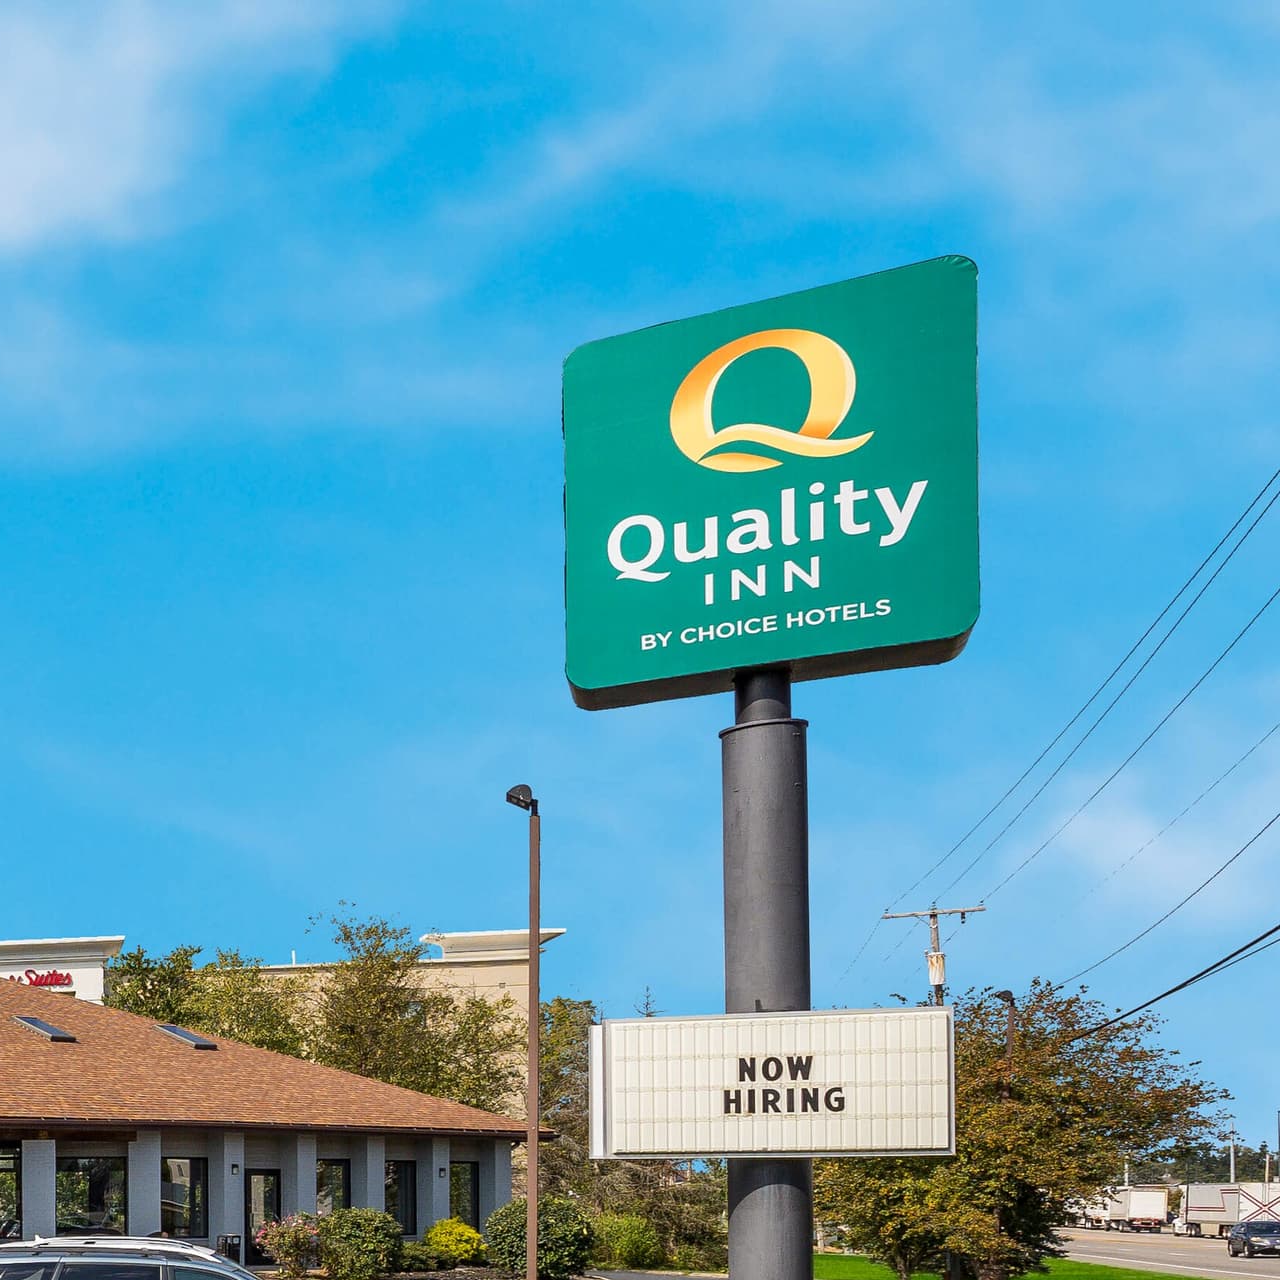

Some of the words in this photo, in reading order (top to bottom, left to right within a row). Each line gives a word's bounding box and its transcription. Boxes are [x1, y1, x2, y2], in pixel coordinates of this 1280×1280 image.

[607, 480, 929, 583] Quality
[704, 556, 821, 606] INN
[640, 631, 673, 651] BY
[680, 615, 778, 645] CHOICE
[786, 598, 892, 629] HOTELS
[24, 969, 73, 987] Suites
[738, 1055, 813, 1082] NOW
[723, 1087, 846, 1114] HIRING
